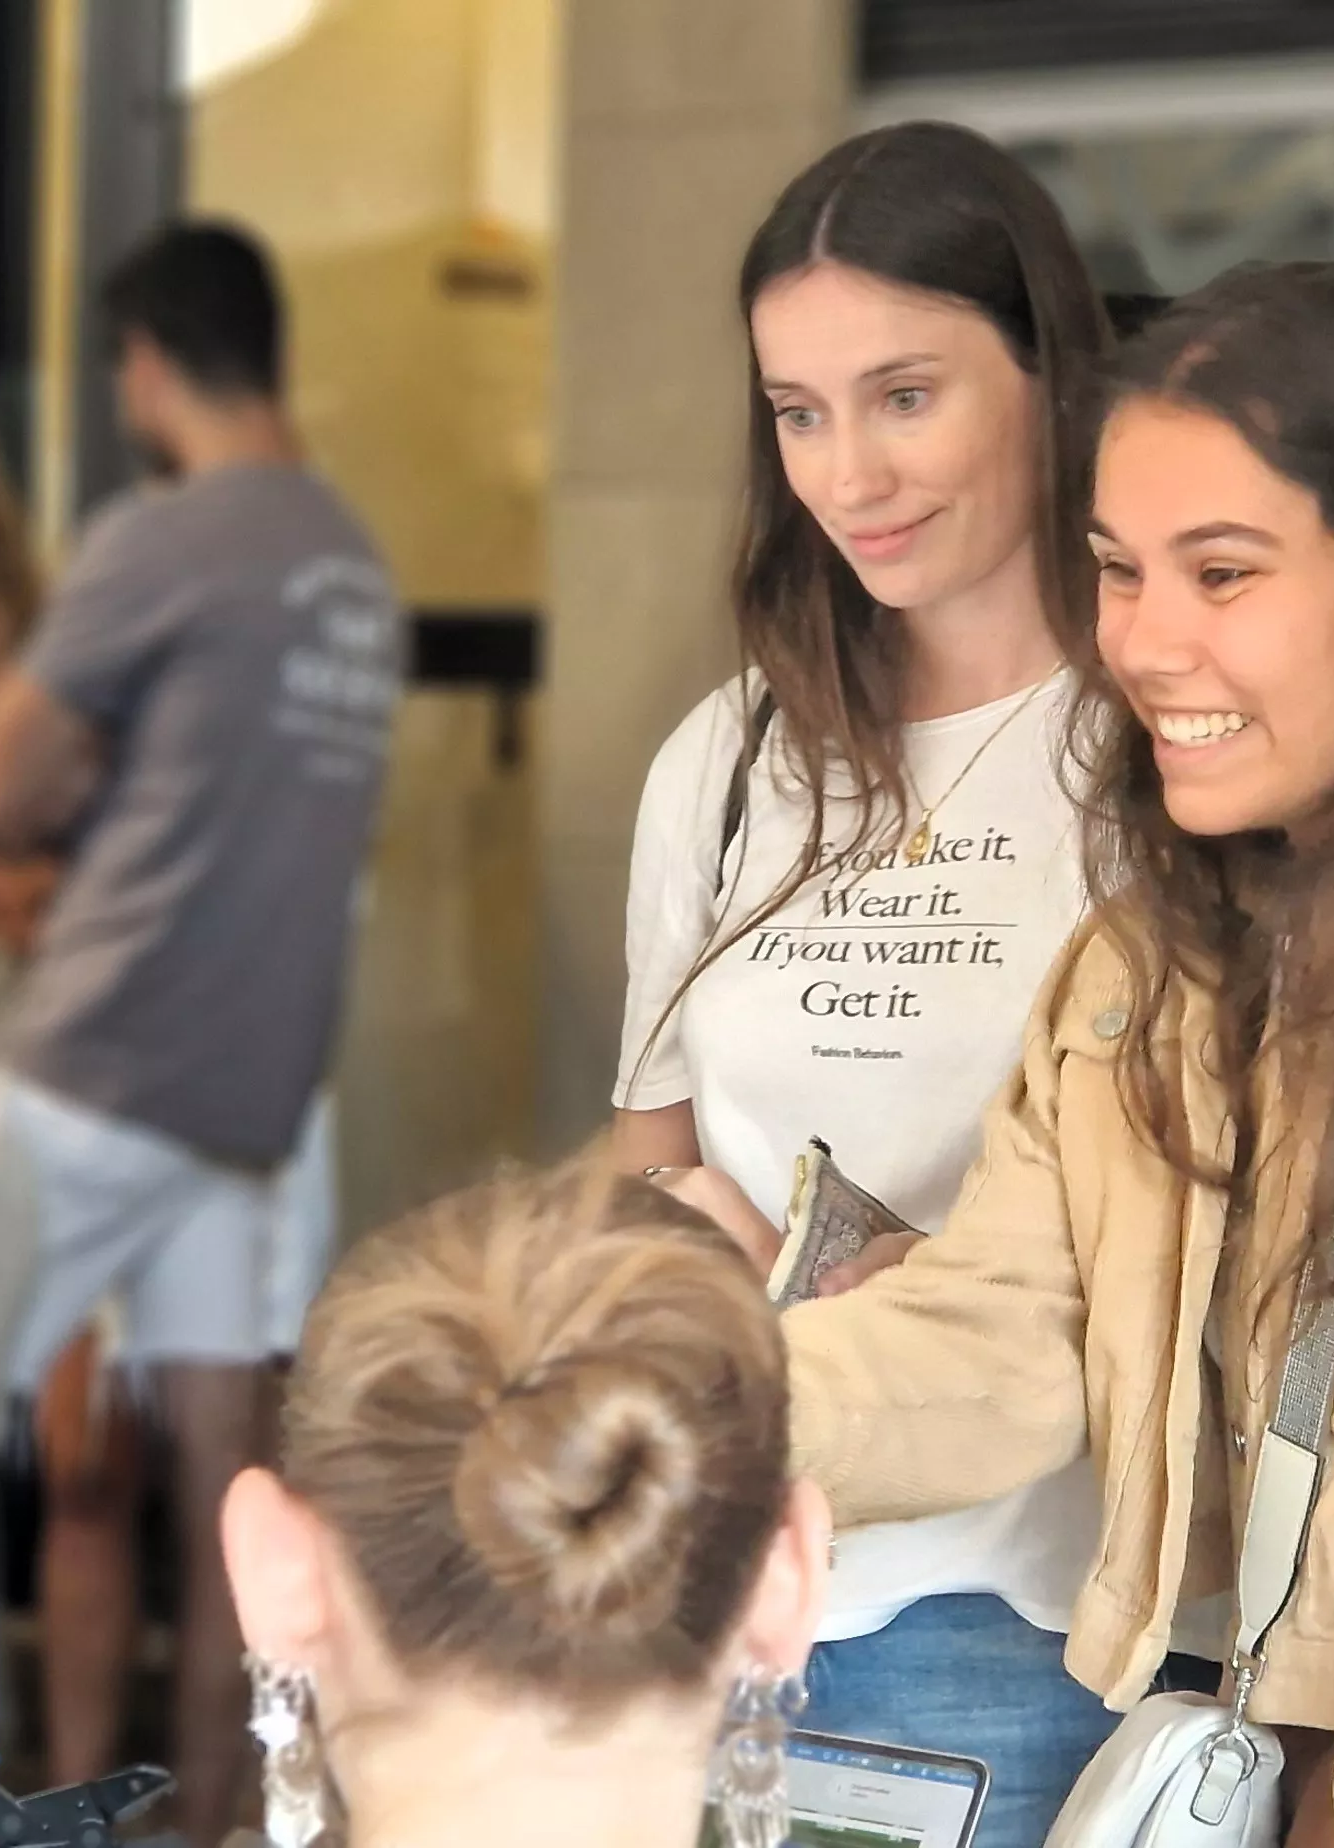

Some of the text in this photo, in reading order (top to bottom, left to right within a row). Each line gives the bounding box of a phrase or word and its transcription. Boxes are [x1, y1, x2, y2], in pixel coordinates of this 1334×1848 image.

[829, 846, 899, 885] you
[978, 827, 1017, 866] it,
[821, 884, 963, 920] Wear it.
[747, 931, 1005, 970] If you want it,
[800, 980, 923, 1019] Get it.
